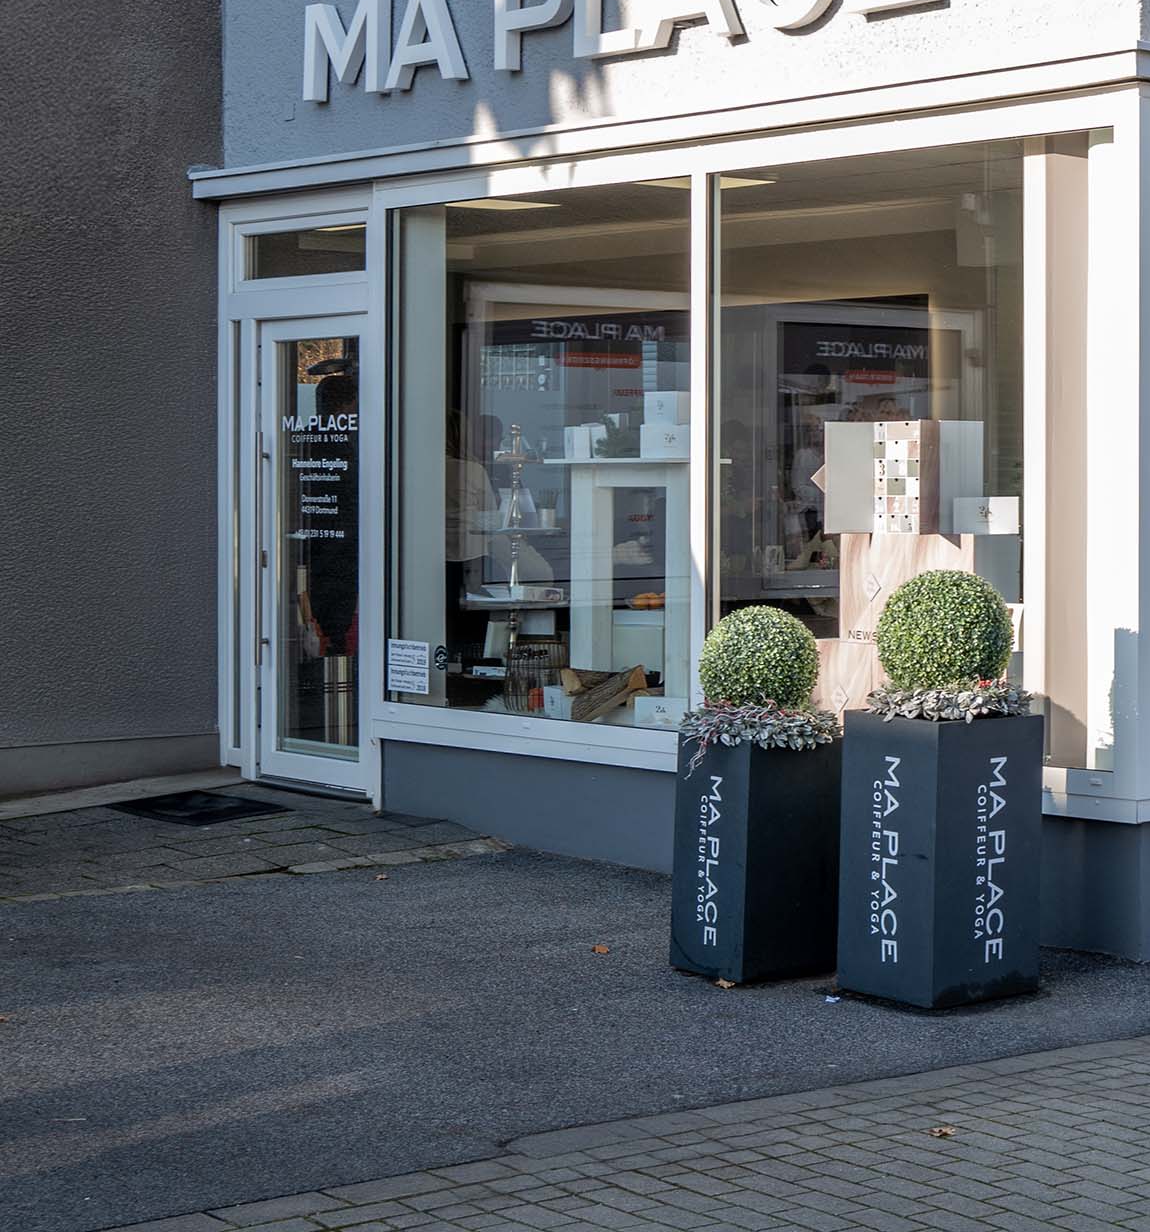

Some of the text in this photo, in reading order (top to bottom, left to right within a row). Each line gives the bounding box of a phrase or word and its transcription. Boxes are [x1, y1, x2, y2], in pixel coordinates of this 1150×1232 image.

[282, 413, 358, 432] MA PLACE
[291, 434, 349, 443] COIFFEUR & YOGA
[696, 886, 705, 922] YOGA
[698, 795, 708, 862] COIFFEUR
[703, 775, 723, 946] MA PLACE
[870, 780, 882, 935] COIFFEUR & YOGA
[880, 755, 901, 963] MA PLACE
[974, 785, 987, 940] COIFFEUR & YOGA
[985, 756, 1008, 963] MA PLACE
